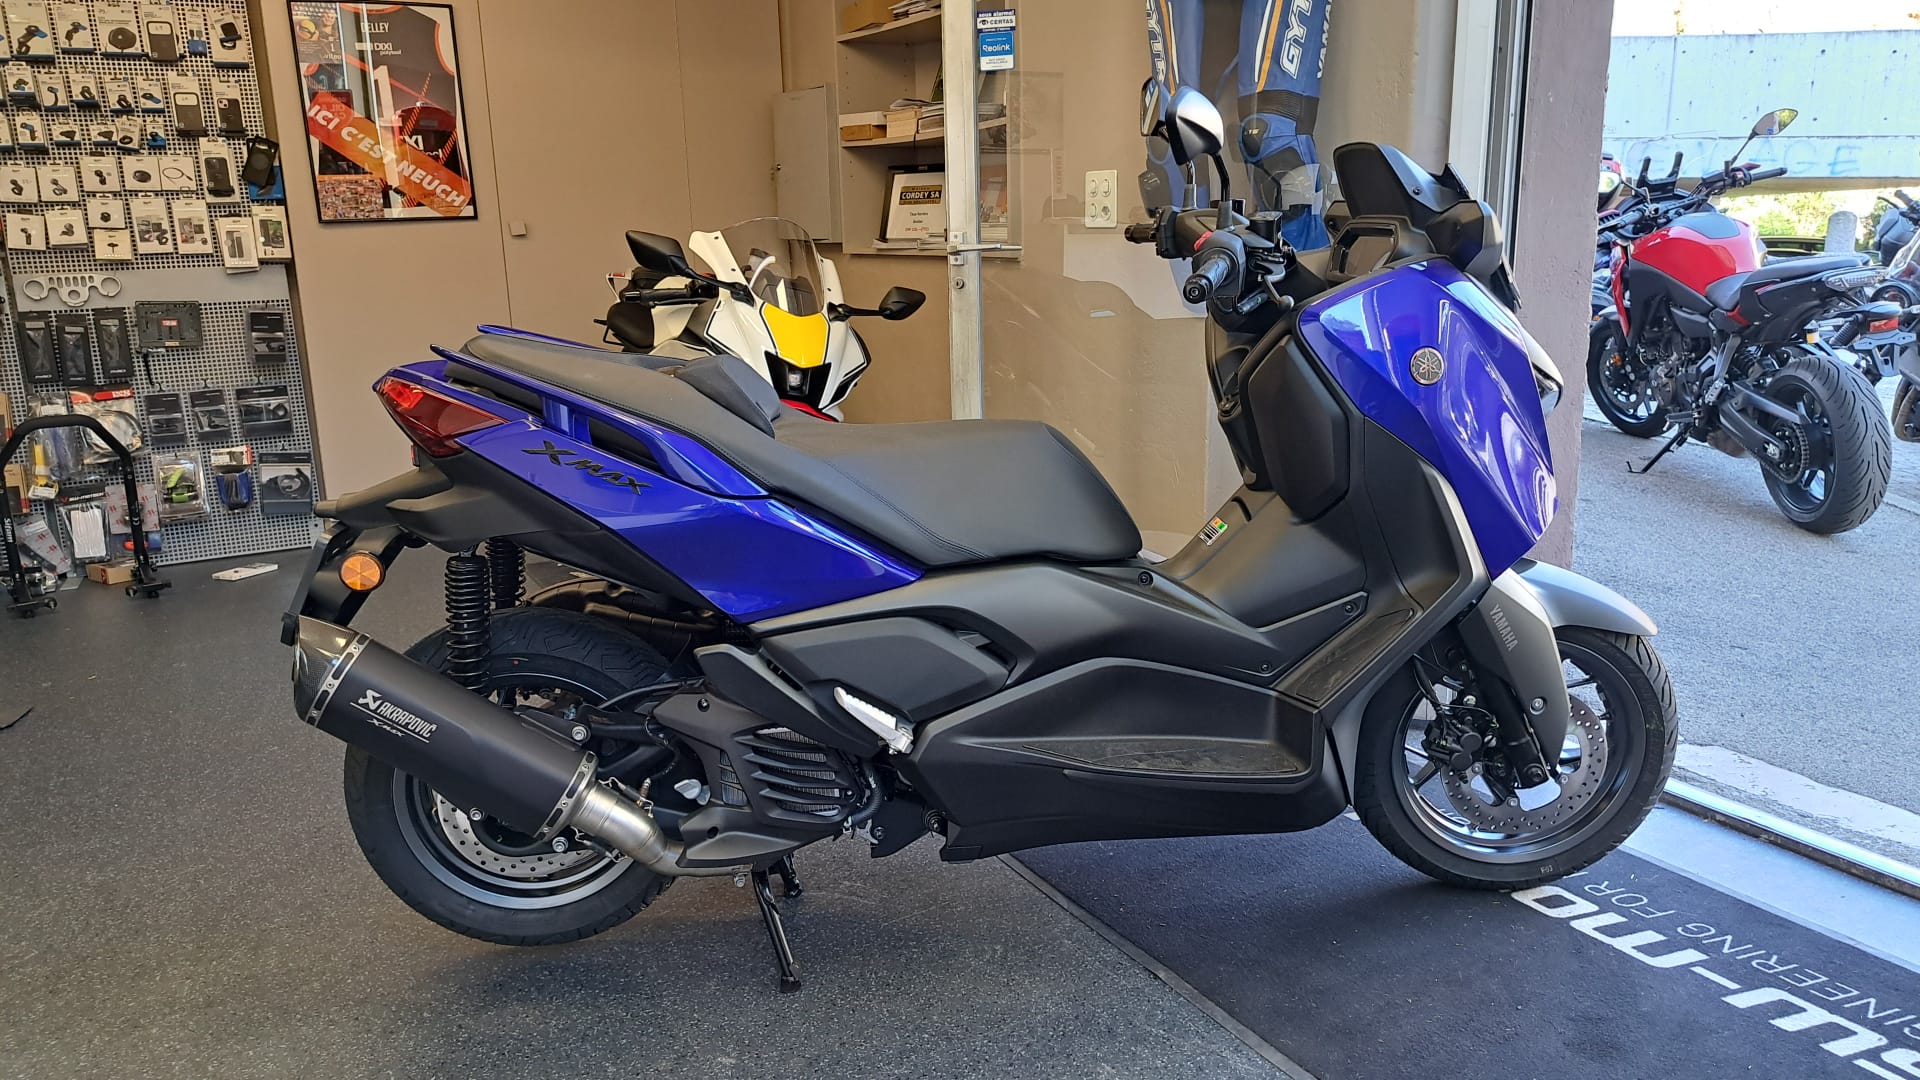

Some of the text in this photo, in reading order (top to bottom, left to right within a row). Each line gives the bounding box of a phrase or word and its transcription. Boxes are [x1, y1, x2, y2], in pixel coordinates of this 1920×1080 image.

[982, 43, 1010, 52] Reolink
[308, 104, 465, 206] ICI C'EST NEUCH
[902, 191, 929, 199] CORDEY
[1490, 603, 1518, 652] YAMAHA
[1582, 880, 1676, 918] FOR
